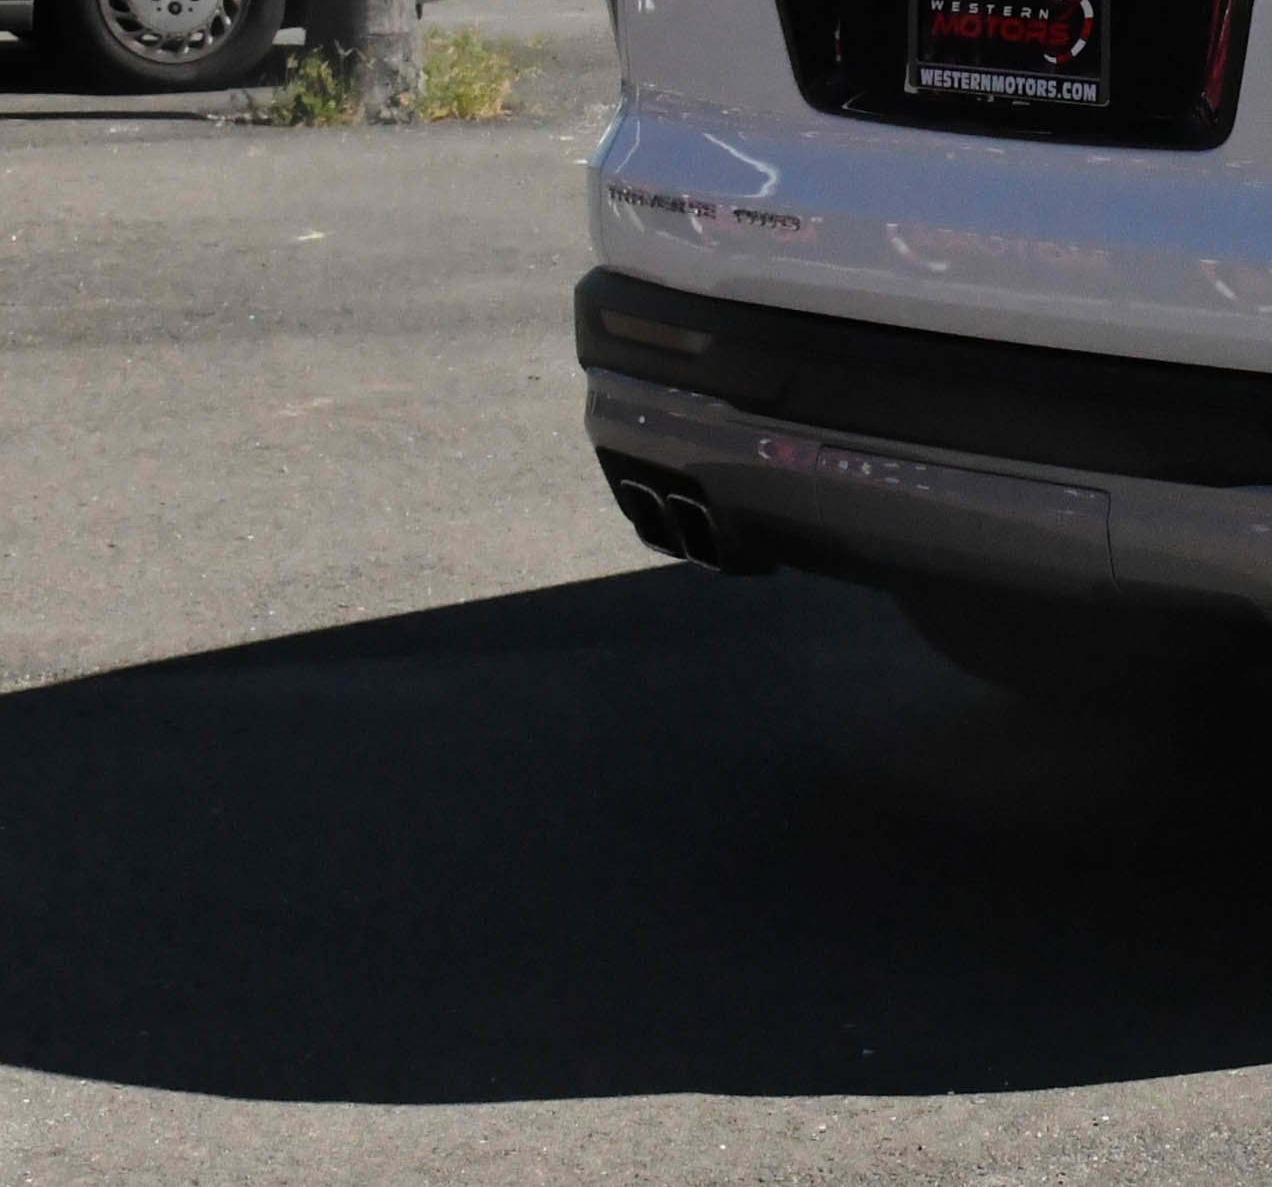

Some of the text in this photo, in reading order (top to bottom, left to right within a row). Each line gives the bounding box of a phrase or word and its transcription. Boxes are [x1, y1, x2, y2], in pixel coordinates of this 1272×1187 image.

[931, 0, 1049, 20] WESTERN
[932, 15, 1071, 45] MOTORS
[920, 68, 1097, 102] WESTERNMOTORS.COM
